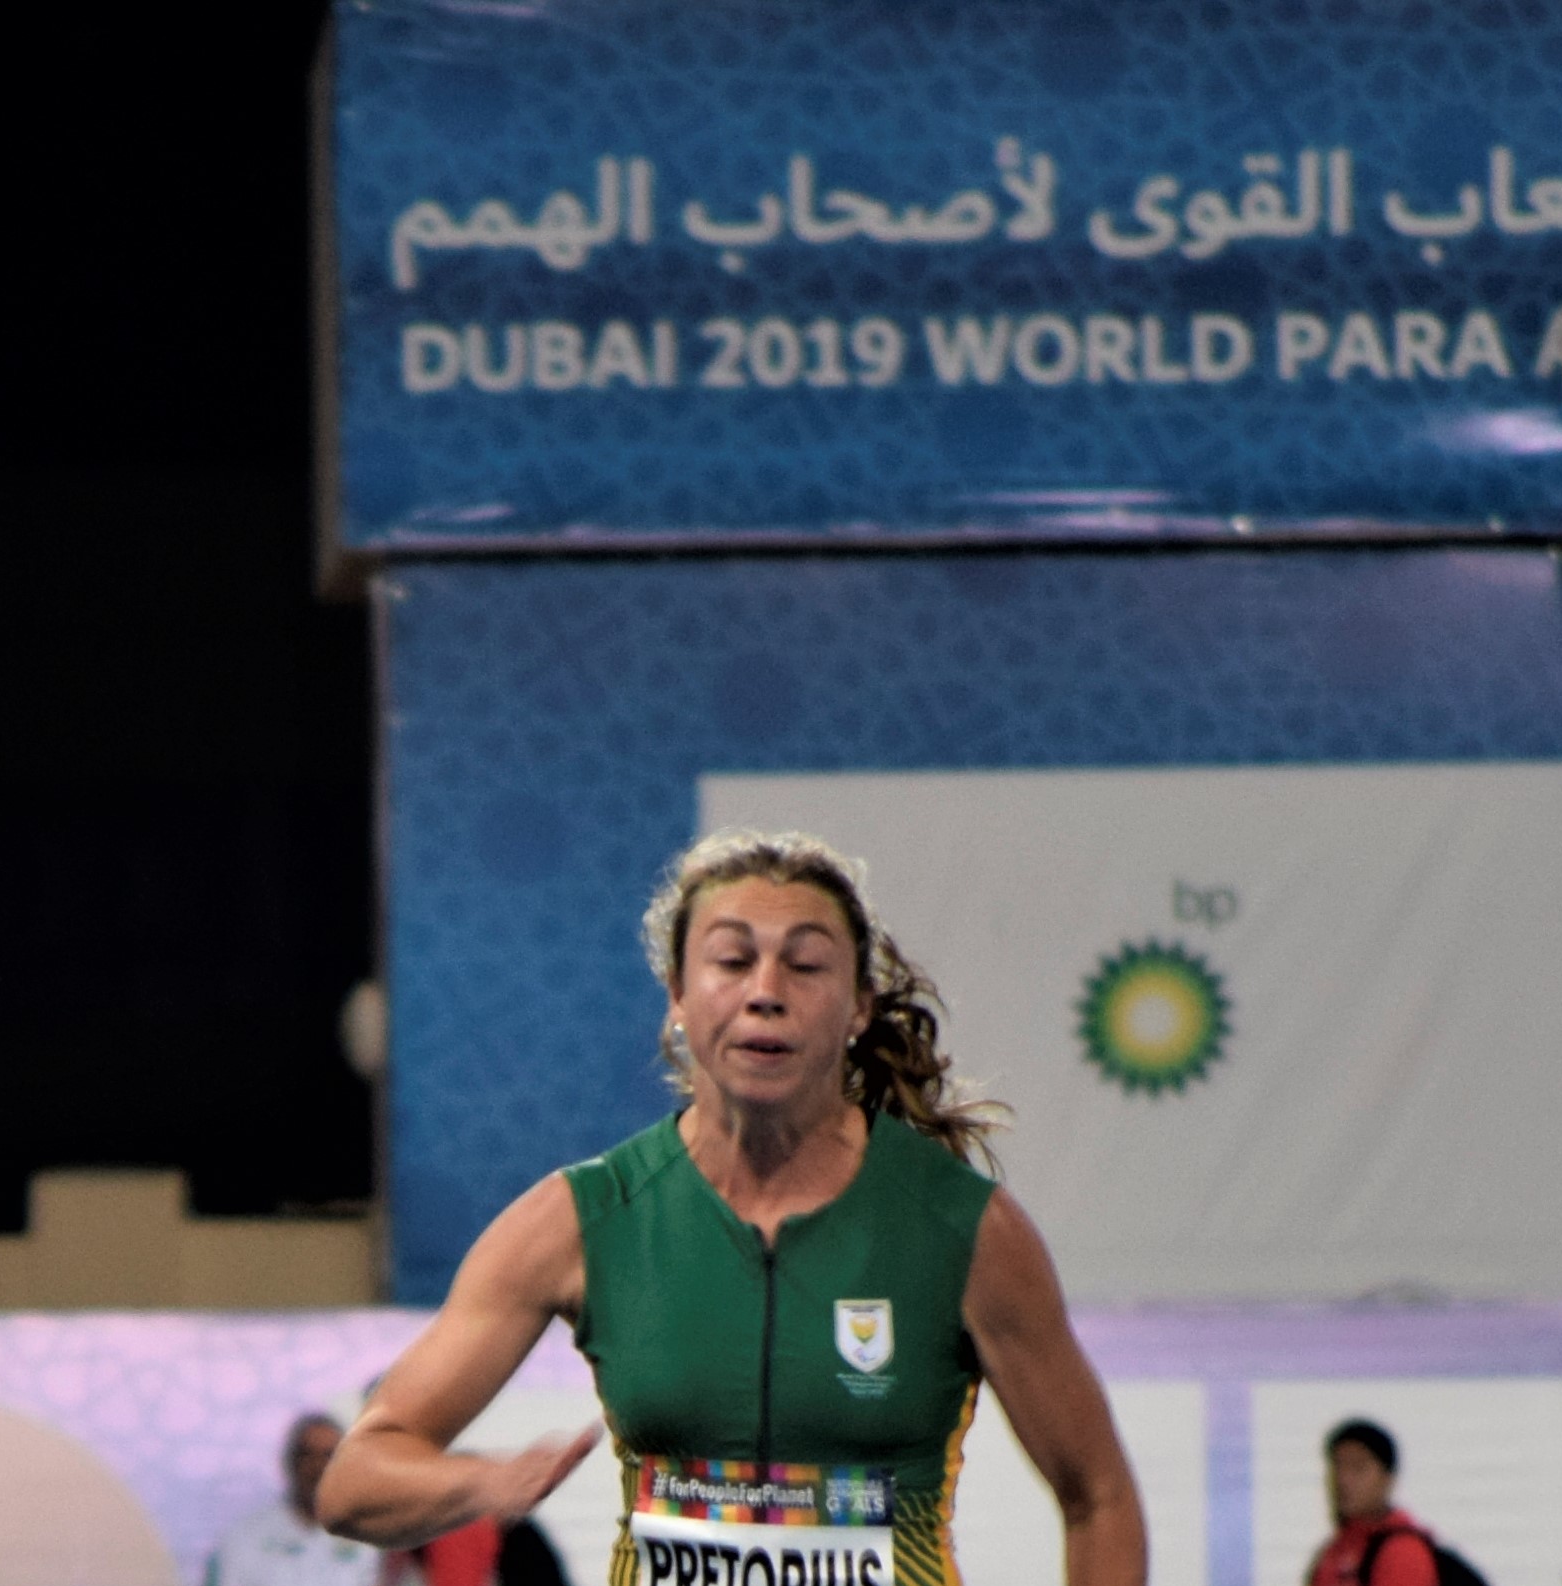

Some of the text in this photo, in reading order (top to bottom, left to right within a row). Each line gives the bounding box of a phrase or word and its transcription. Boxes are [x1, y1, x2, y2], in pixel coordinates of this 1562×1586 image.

[390, 155, 653, 290] الهمم
[681, 135, 1057, 274] لأصحاب
[1087, 147, 1353, 260] القوى
[402, 320, 676, 393] DUBAI
[699, 315, 903, 388] 2019
[924, 313, 1256, 385] WORLD
[1276, 311, 1513, 380] PARA
[1171, 877, 1239, 931] bp
